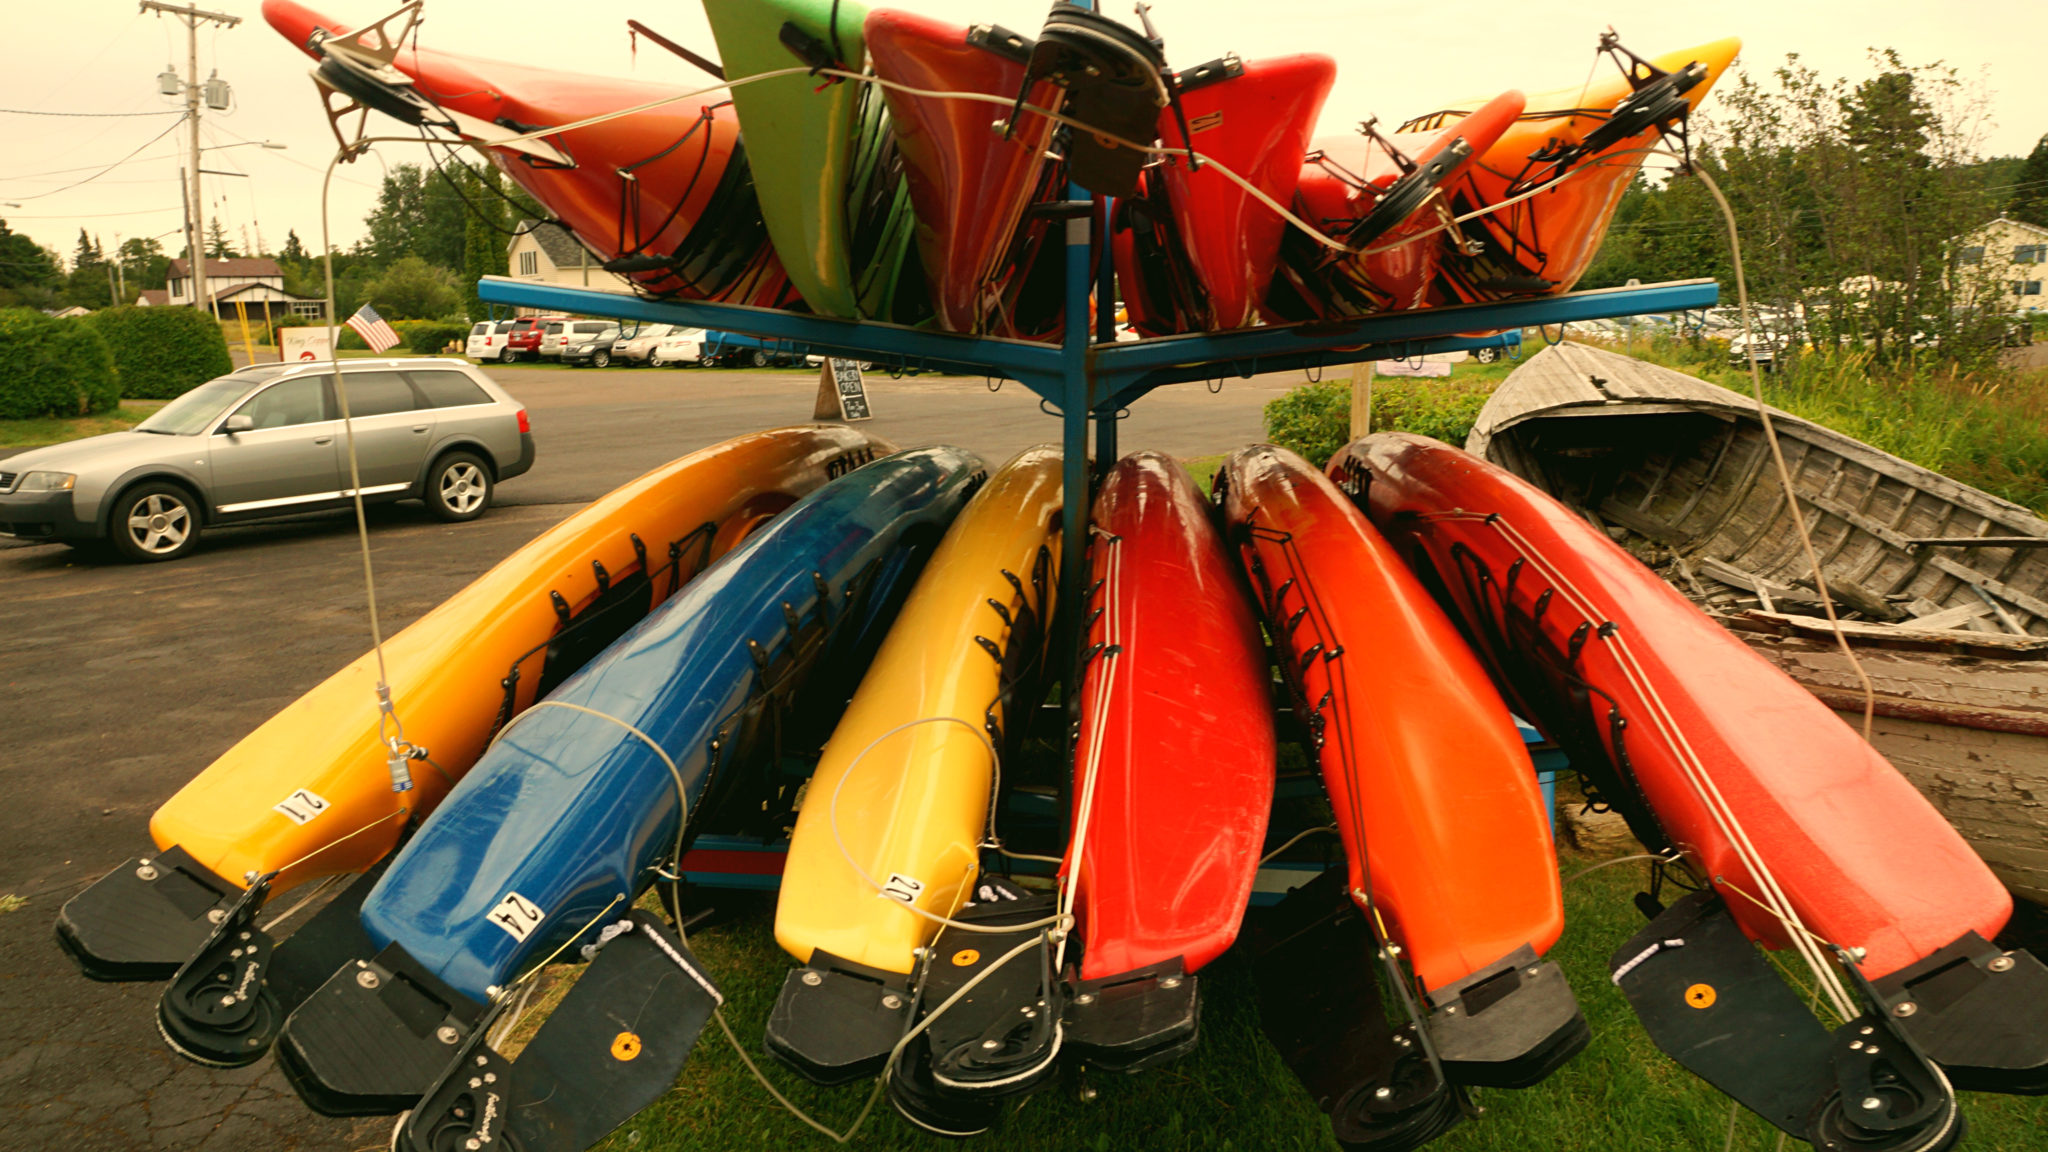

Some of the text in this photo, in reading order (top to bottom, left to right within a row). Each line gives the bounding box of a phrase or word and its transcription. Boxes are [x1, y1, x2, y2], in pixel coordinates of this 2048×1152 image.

[840, 381, 861, 393] OPEN
[279, 791, 323, 821] 21
[885, 875, 920, 902] 20
[494, 895, 538, 935] 24
